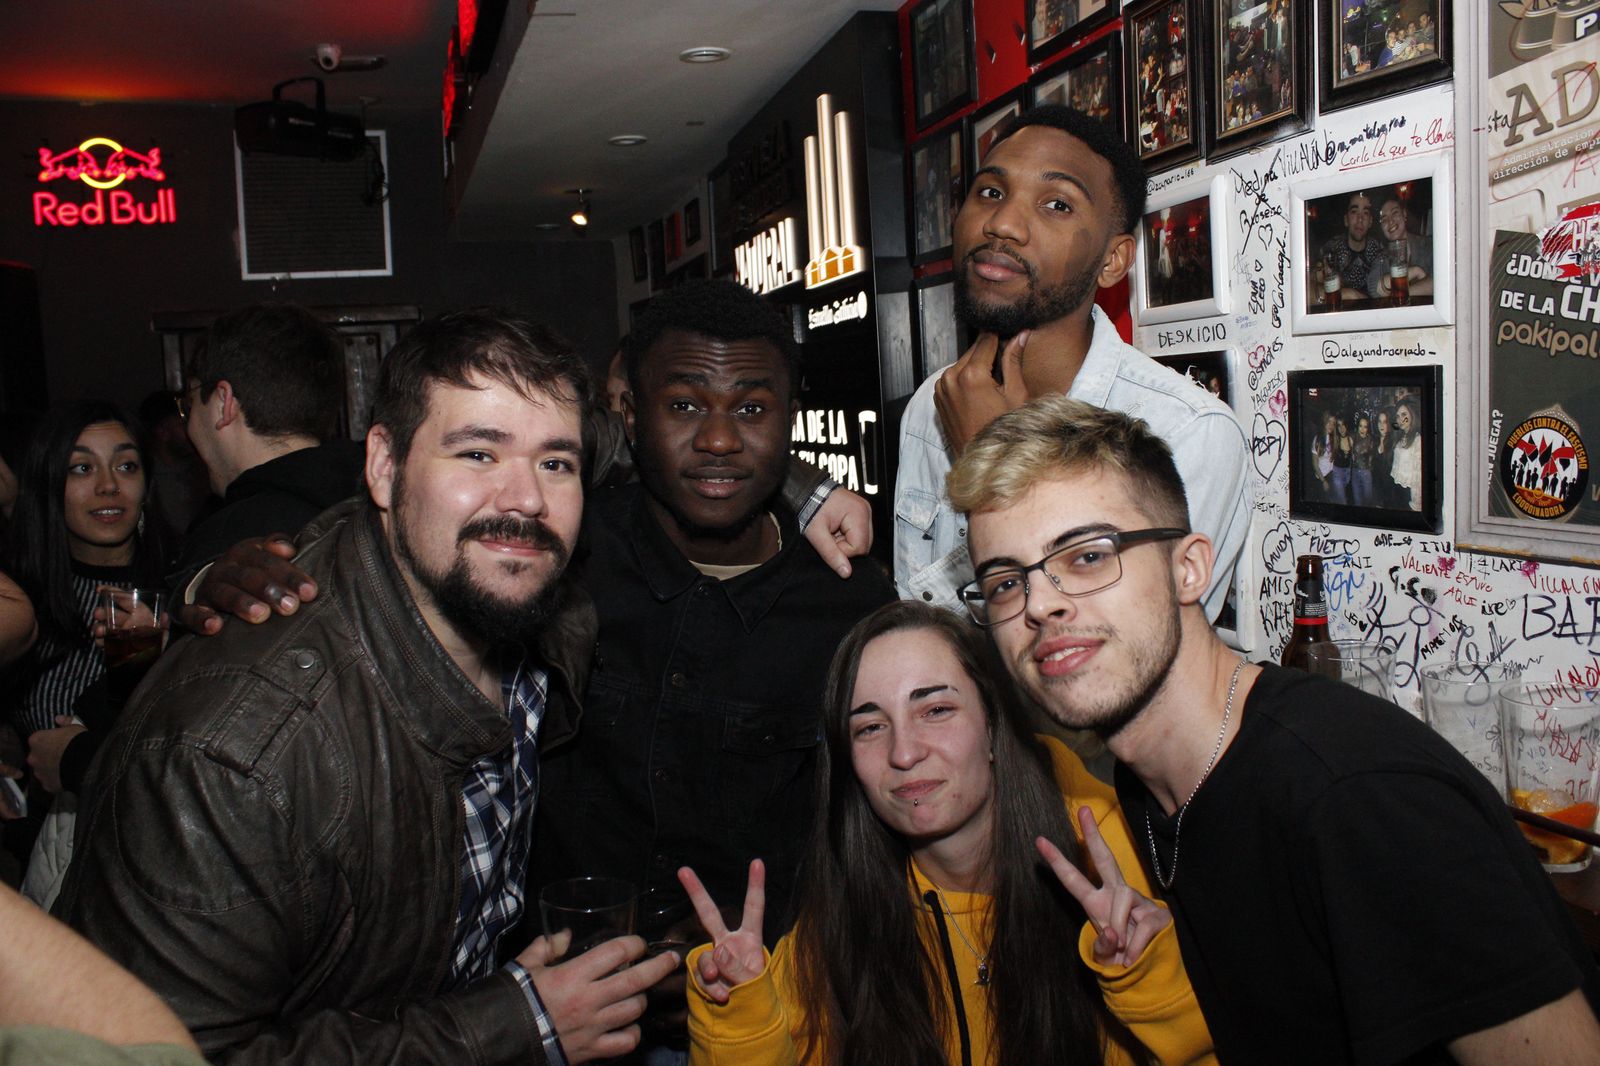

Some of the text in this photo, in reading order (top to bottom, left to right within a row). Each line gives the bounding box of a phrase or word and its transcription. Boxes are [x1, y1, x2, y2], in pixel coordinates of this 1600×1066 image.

[1555, 148, 1568, 159] de
[33, 188, 177, 227] Red Bull
[1500, 290, 1525, 311] DE
[1528, 294, 1555, 316] LA
[807, 410, 827, 444] DE
[828, 410, 848, 445] LA
[1507, 417, 1588, 470] PUEBLOS CONTRA EL FASCISMO
[1512, 492, 1566, 518] COORDINADORA
